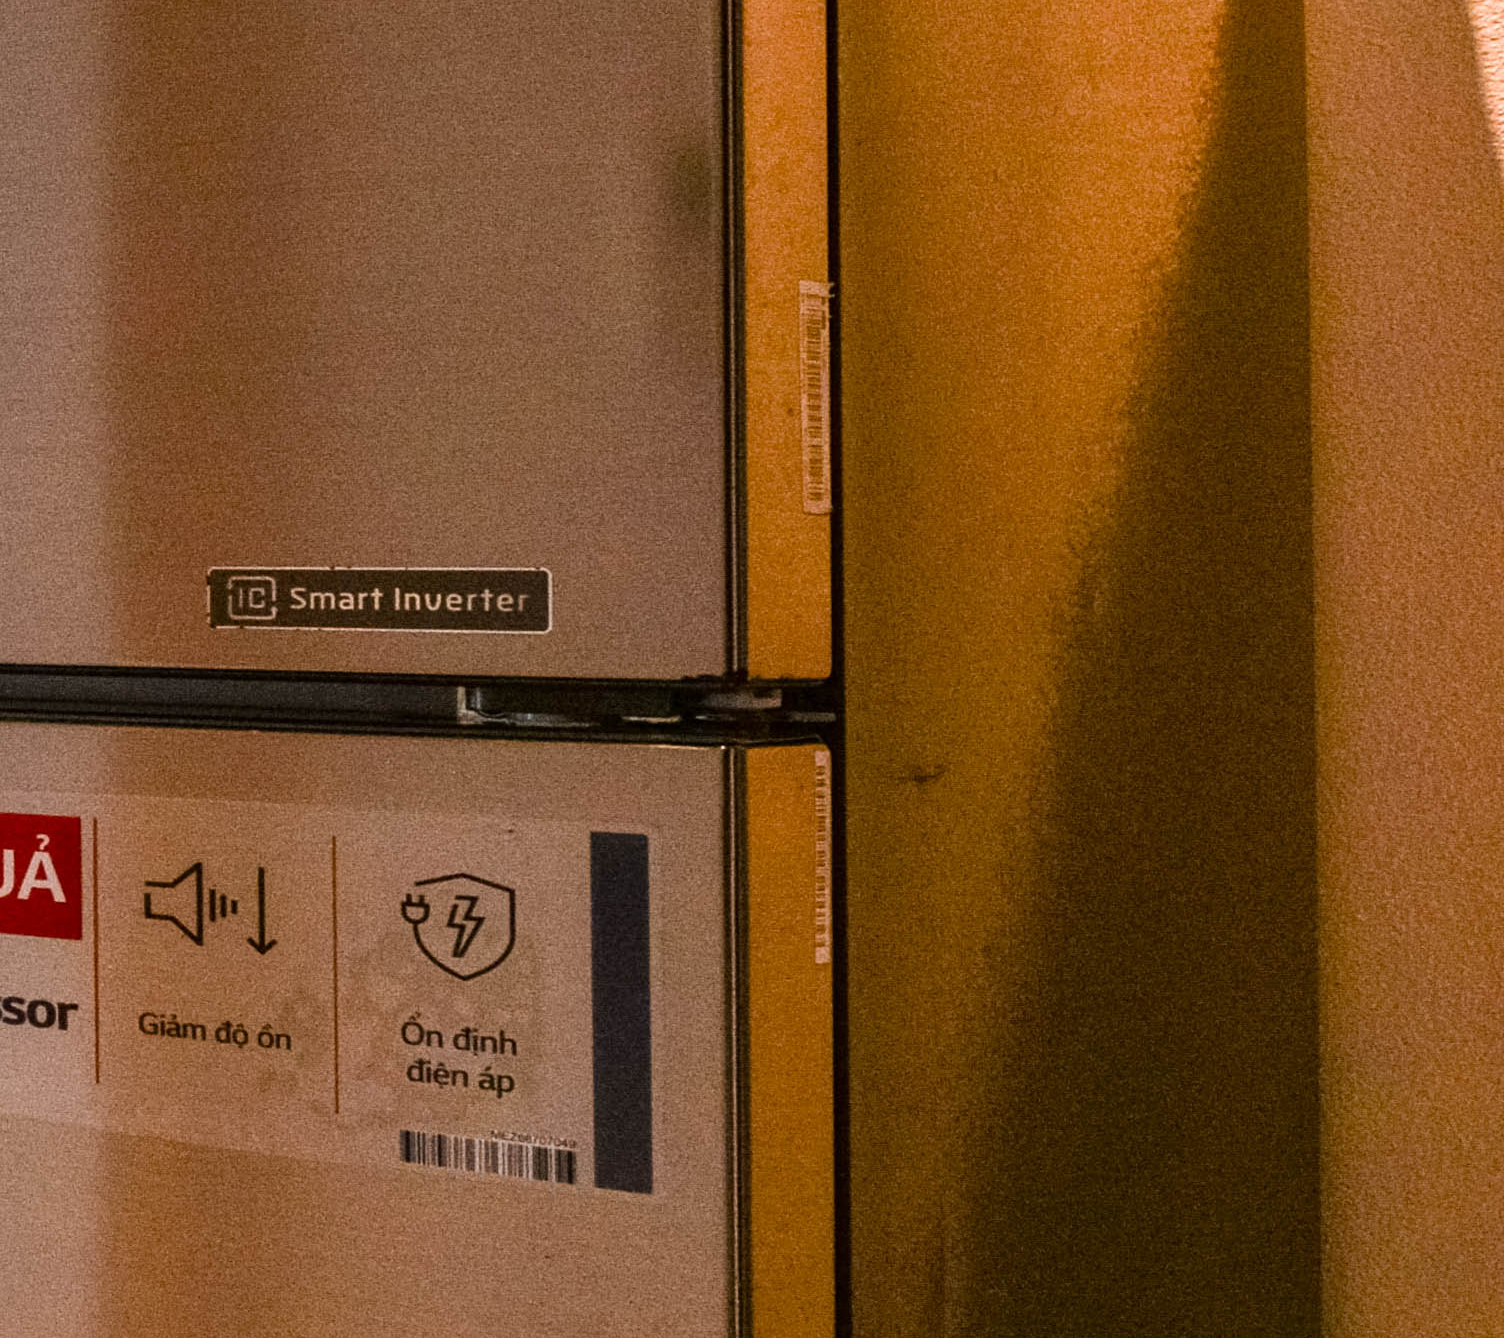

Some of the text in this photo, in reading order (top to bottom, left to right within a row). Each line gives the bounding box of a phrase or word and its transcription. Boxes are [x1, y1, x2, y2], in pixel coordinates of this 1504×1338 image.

[290, 587, 384, 611] Smart
[394, 588, 529, 612] Inverter
[138, 1012, 207, 1041] Giảm
[215, 1021, 249, 1049] độ
[401, 1011, 517, 1057] Ổn định
[407, 1058, 515, 1099] điện áp
